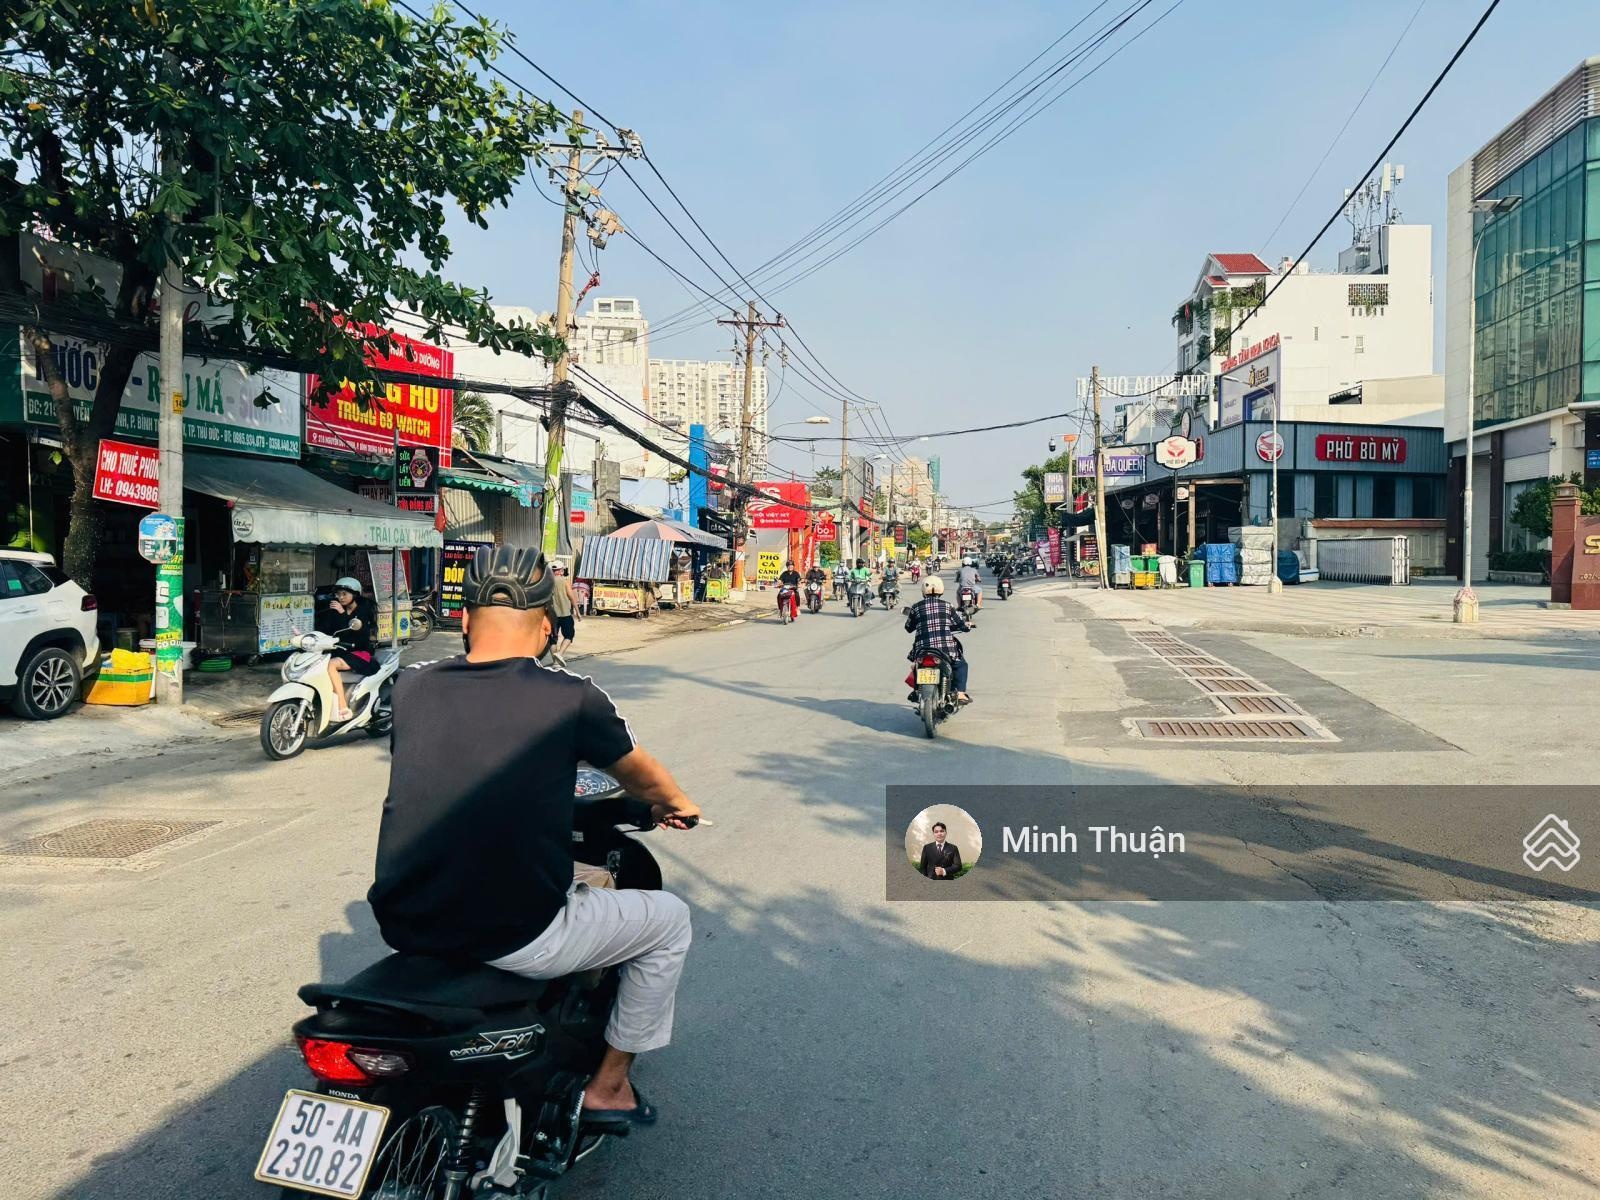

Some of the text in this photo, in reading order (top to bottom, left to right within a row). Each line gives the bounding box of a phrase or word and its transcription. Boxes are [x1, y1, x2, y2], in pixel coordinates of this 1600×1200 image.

[195, 370, 224, 415] MÁ
[379, 412, 394, 429] 68
[396, 414, 431, 438] WATCH
[1326, 436, 1399, 460] PHỞ BÒ MỸ
[101, 449, 160, 480] CHO THUÊ PHÒN
[1079, 460, 1094, 473] NHA
[1117, 459, 1143, 472] QUEEN
[100, 477, 159, 503] LH: 0943986
[393, 524, 411, 544] CÂY
[443, 560, 465, 583] ĐỒN
[328, 1089, 361, 1100] HONDA
[290, 1099, 369, 1148] 50-AA
[266, 1138, 363, 1190] 230.82
